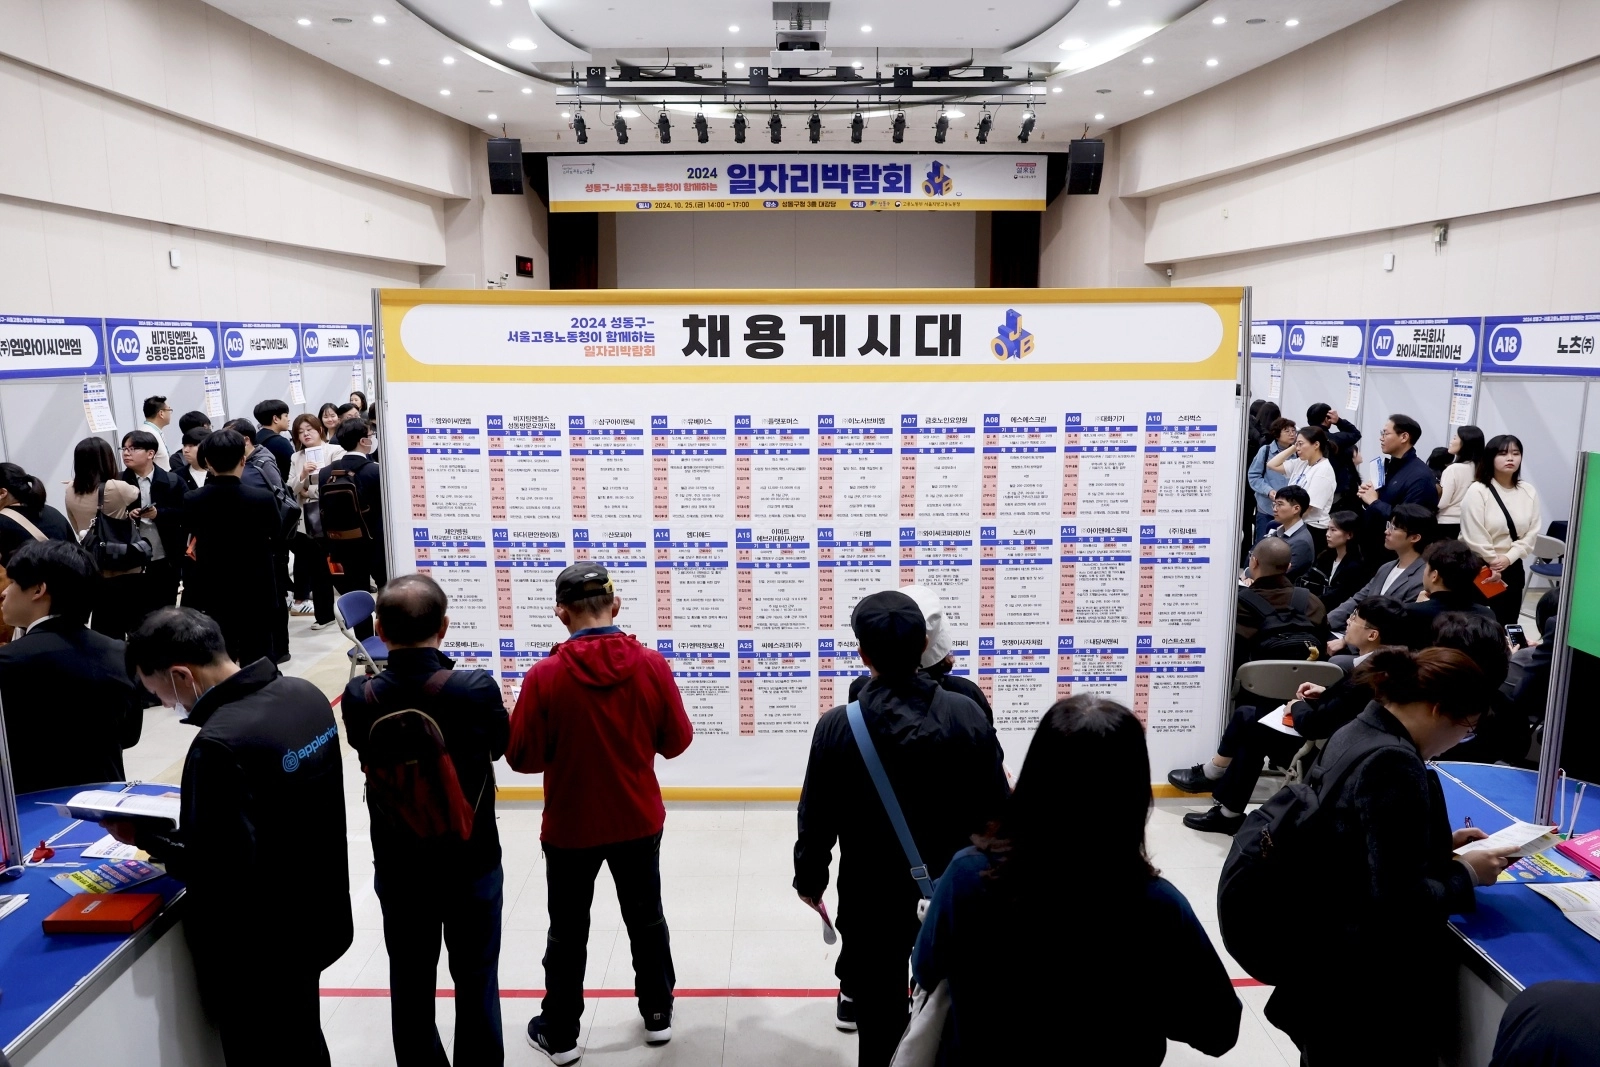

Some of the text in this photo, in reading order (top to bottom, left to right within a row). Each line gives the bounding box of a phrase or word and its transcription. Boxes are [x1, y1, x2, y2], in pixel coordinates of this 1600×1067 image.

[686, 167, 718, 179] 2024
[726, 163, 912, 195] 일자리박람회
[585, 182, 718, 193] 성동구-서울고용노동청이 함께하는
[707, 201, 725, 209] 14:00
[570, 316, 655, 330] 2024 성동구-
[151, 330, 198, 345] 비지팅엔젤스
[305, 337, 319, 349] A04
[507, 330, 656, 344] 서울고용노동청이 함께하는
[1291, 334, 1303, 346] A16
[1375, 335, 1391, 350] A17
[1413, 328, 1446, 344] 주식회사
[0, 338, 82, 357] 주)엠와이씨앤엠
[116, 337, 139, 354] A02
[227, 338, 243, 352] A03
[583, 344, 656, 358] 일자리박람회
[1396, 343, 1462, 361] 와이씨코퍼레이션
[1495, 336, 1518, 354] A18
[145, 346, 206, 362] 성동방문요양지점
[981, 529, 995, 537] A18
